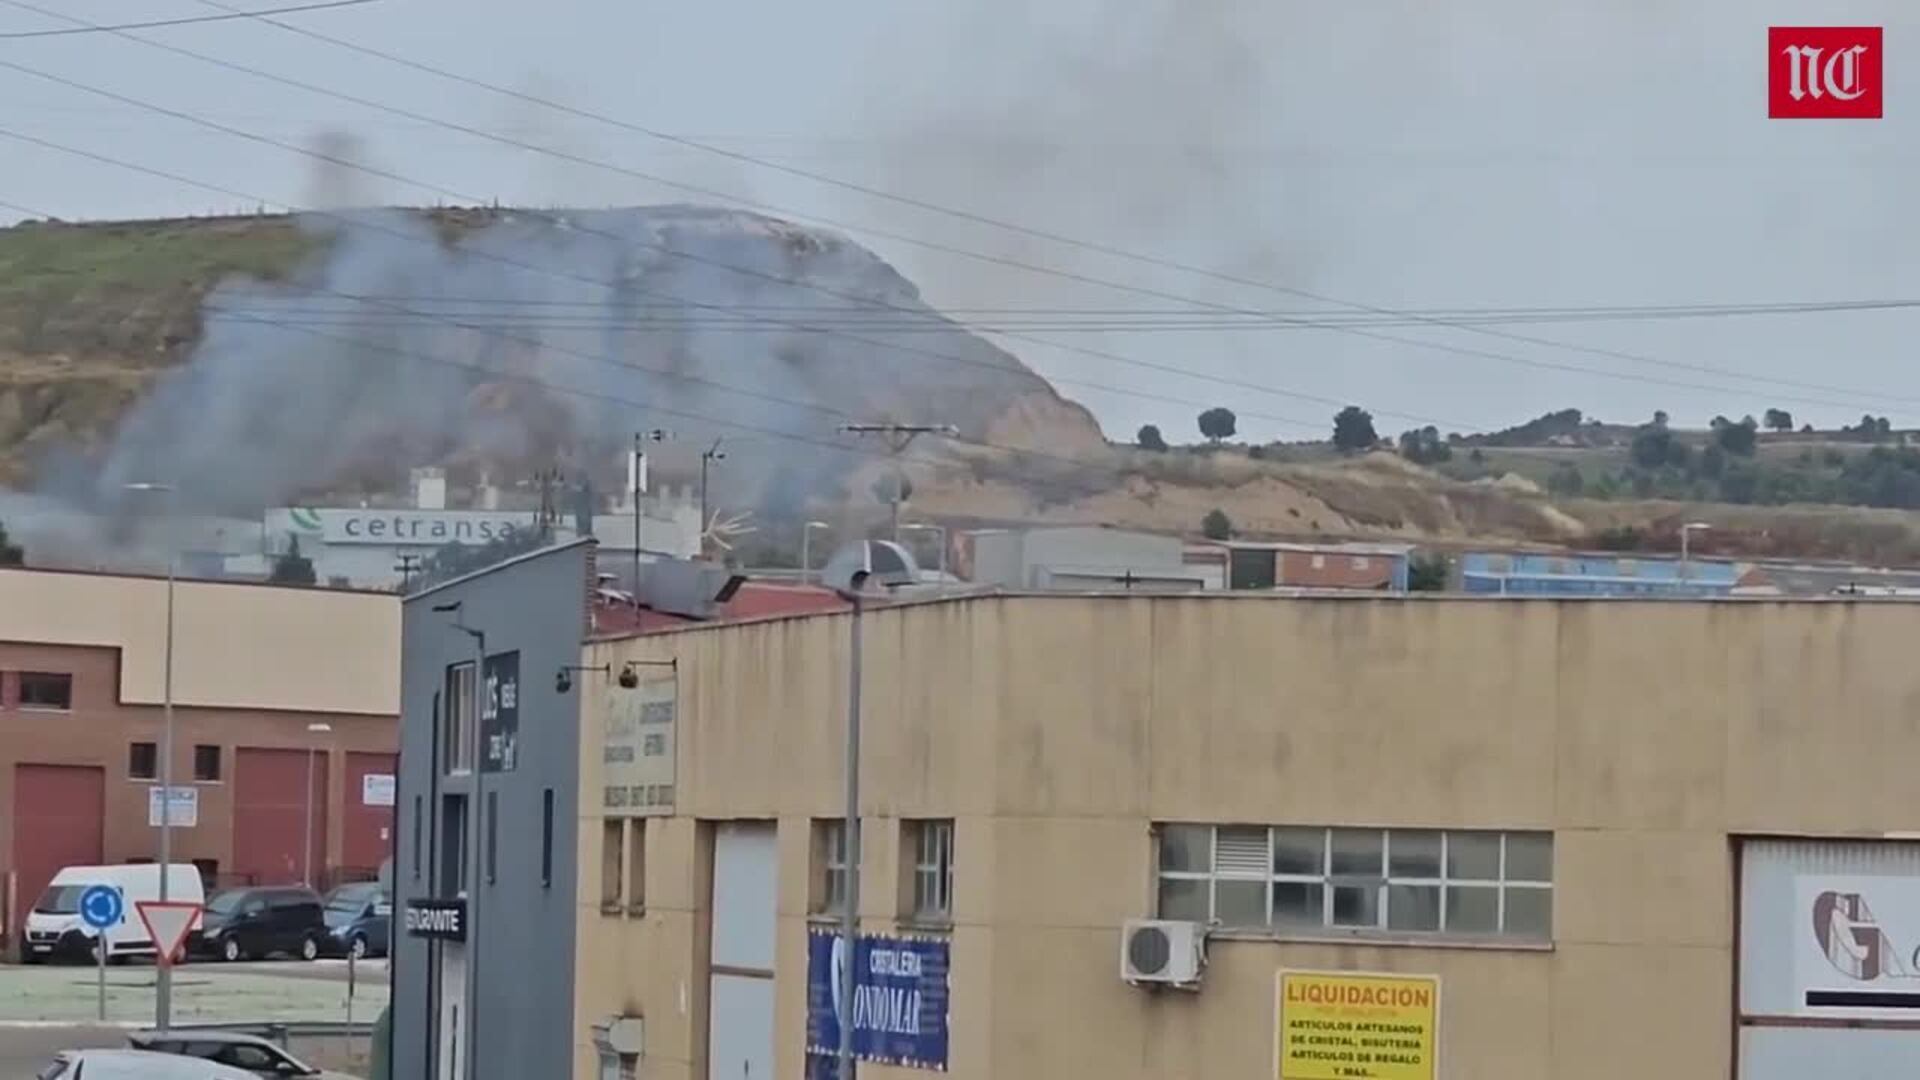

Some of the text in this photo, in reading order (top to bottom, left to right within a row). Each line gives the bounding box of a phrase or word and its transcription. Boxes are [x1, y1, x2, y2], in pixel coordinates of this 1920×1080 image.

[345, 515, 516, 539] cetransa
[1287, 983, 1430, 1008] LIQUIDACIÓN
[1290, 1020, 1423, 1034] ARTICULOS ARTESANOS
[1291, 1035, 1305, 1044] DE
[1357, 1053, 1371, 1062] DE
[1375, 1053, 1421, 1065] REGALO
